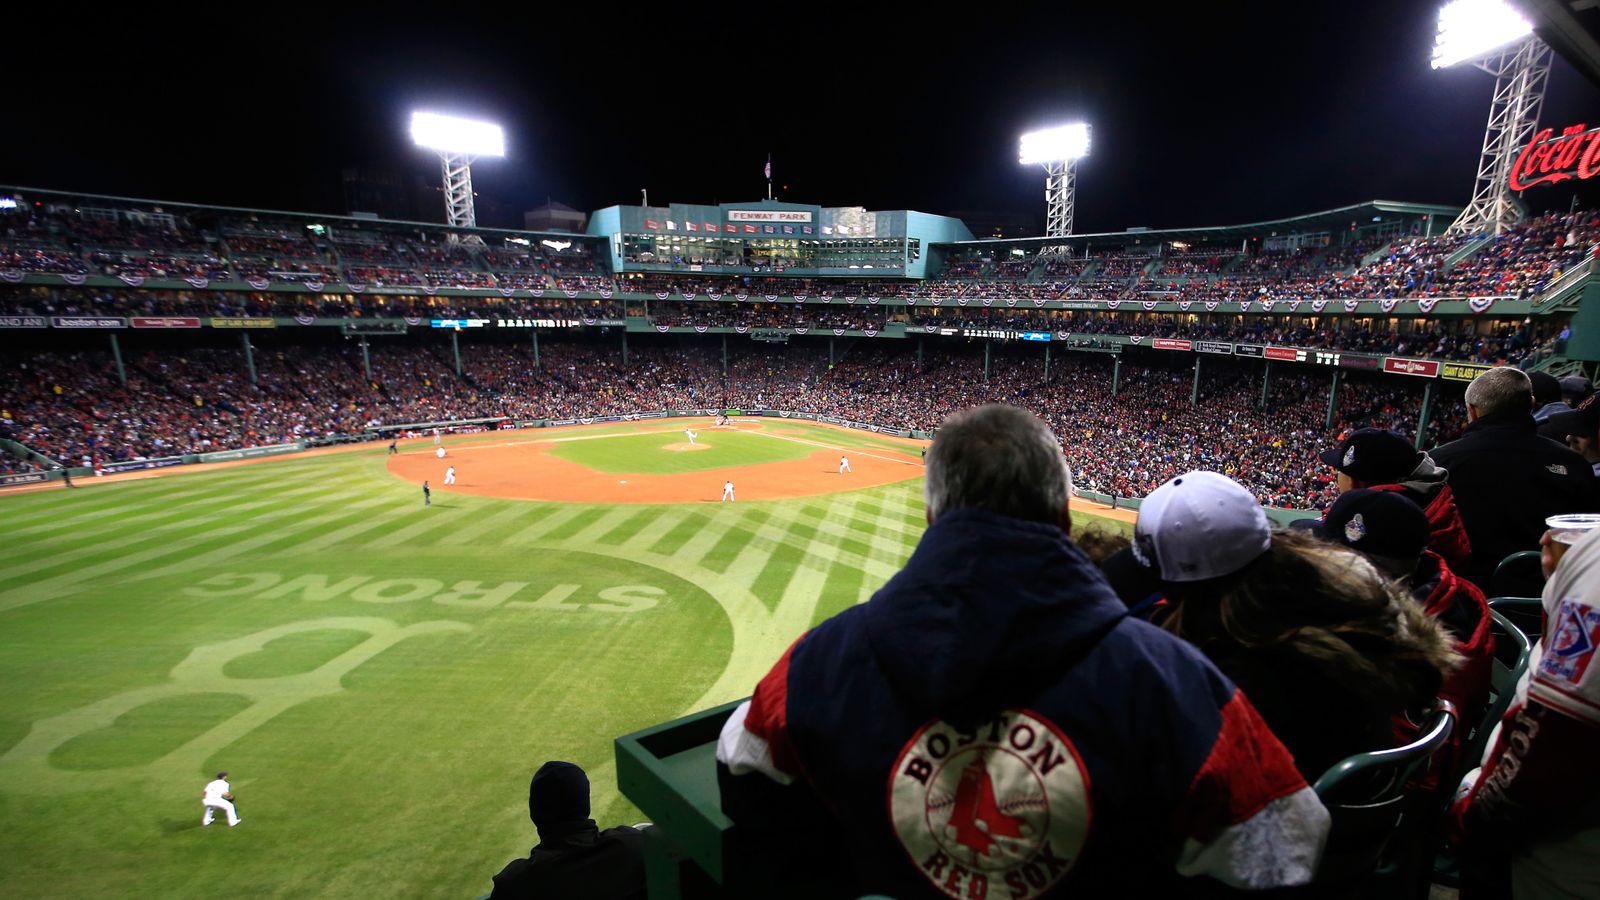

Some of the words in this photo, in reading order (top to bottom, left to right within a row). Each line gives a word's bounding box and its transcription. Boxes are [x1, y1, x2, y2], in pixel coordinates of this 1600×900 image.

[733, 212, 774, 220] FENWAY
[779, 212, 806, 220] PARK
[1443, 366, 1458, 377] GIANT
[1459, 367, 1474, 379] GLASS
[184, 571, 667, 613] STRONG
[904, 717, 1067, 786] BOSTON
[924, 848, 988, 900] RED
[1004, 841, 1067, 900] SOX
